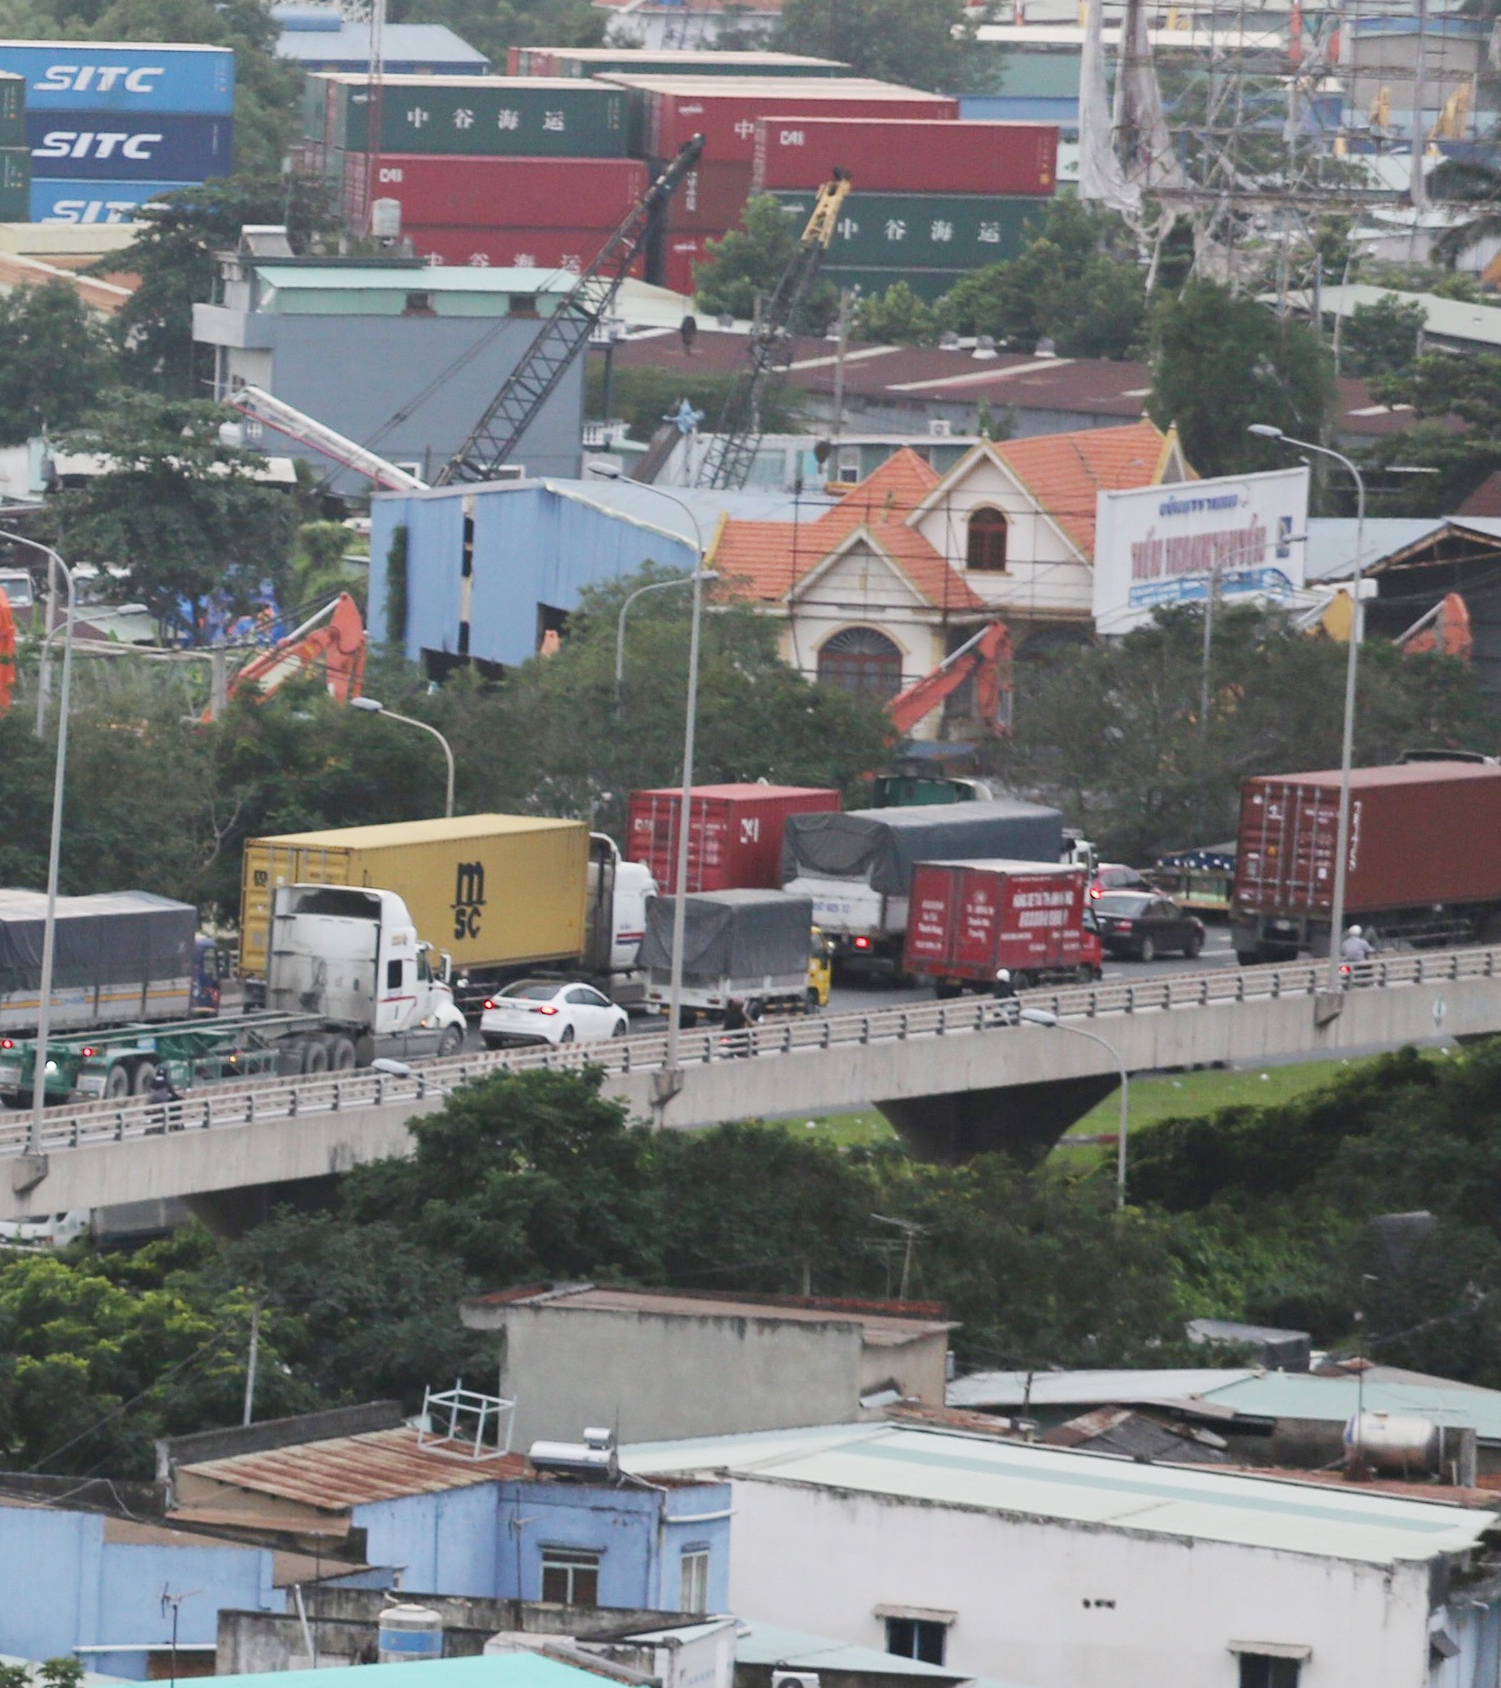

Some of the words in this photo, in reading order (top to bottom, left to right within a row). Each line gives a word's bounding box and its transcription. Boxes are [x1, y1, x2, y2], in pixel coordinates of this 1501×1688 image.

[33, 65, 165, 92] SITC
[407, 106, 565, 131] 中谷海运
[31, 131, 163, 159] SITC
[837, 217, 1000, 243] 中谷海运
